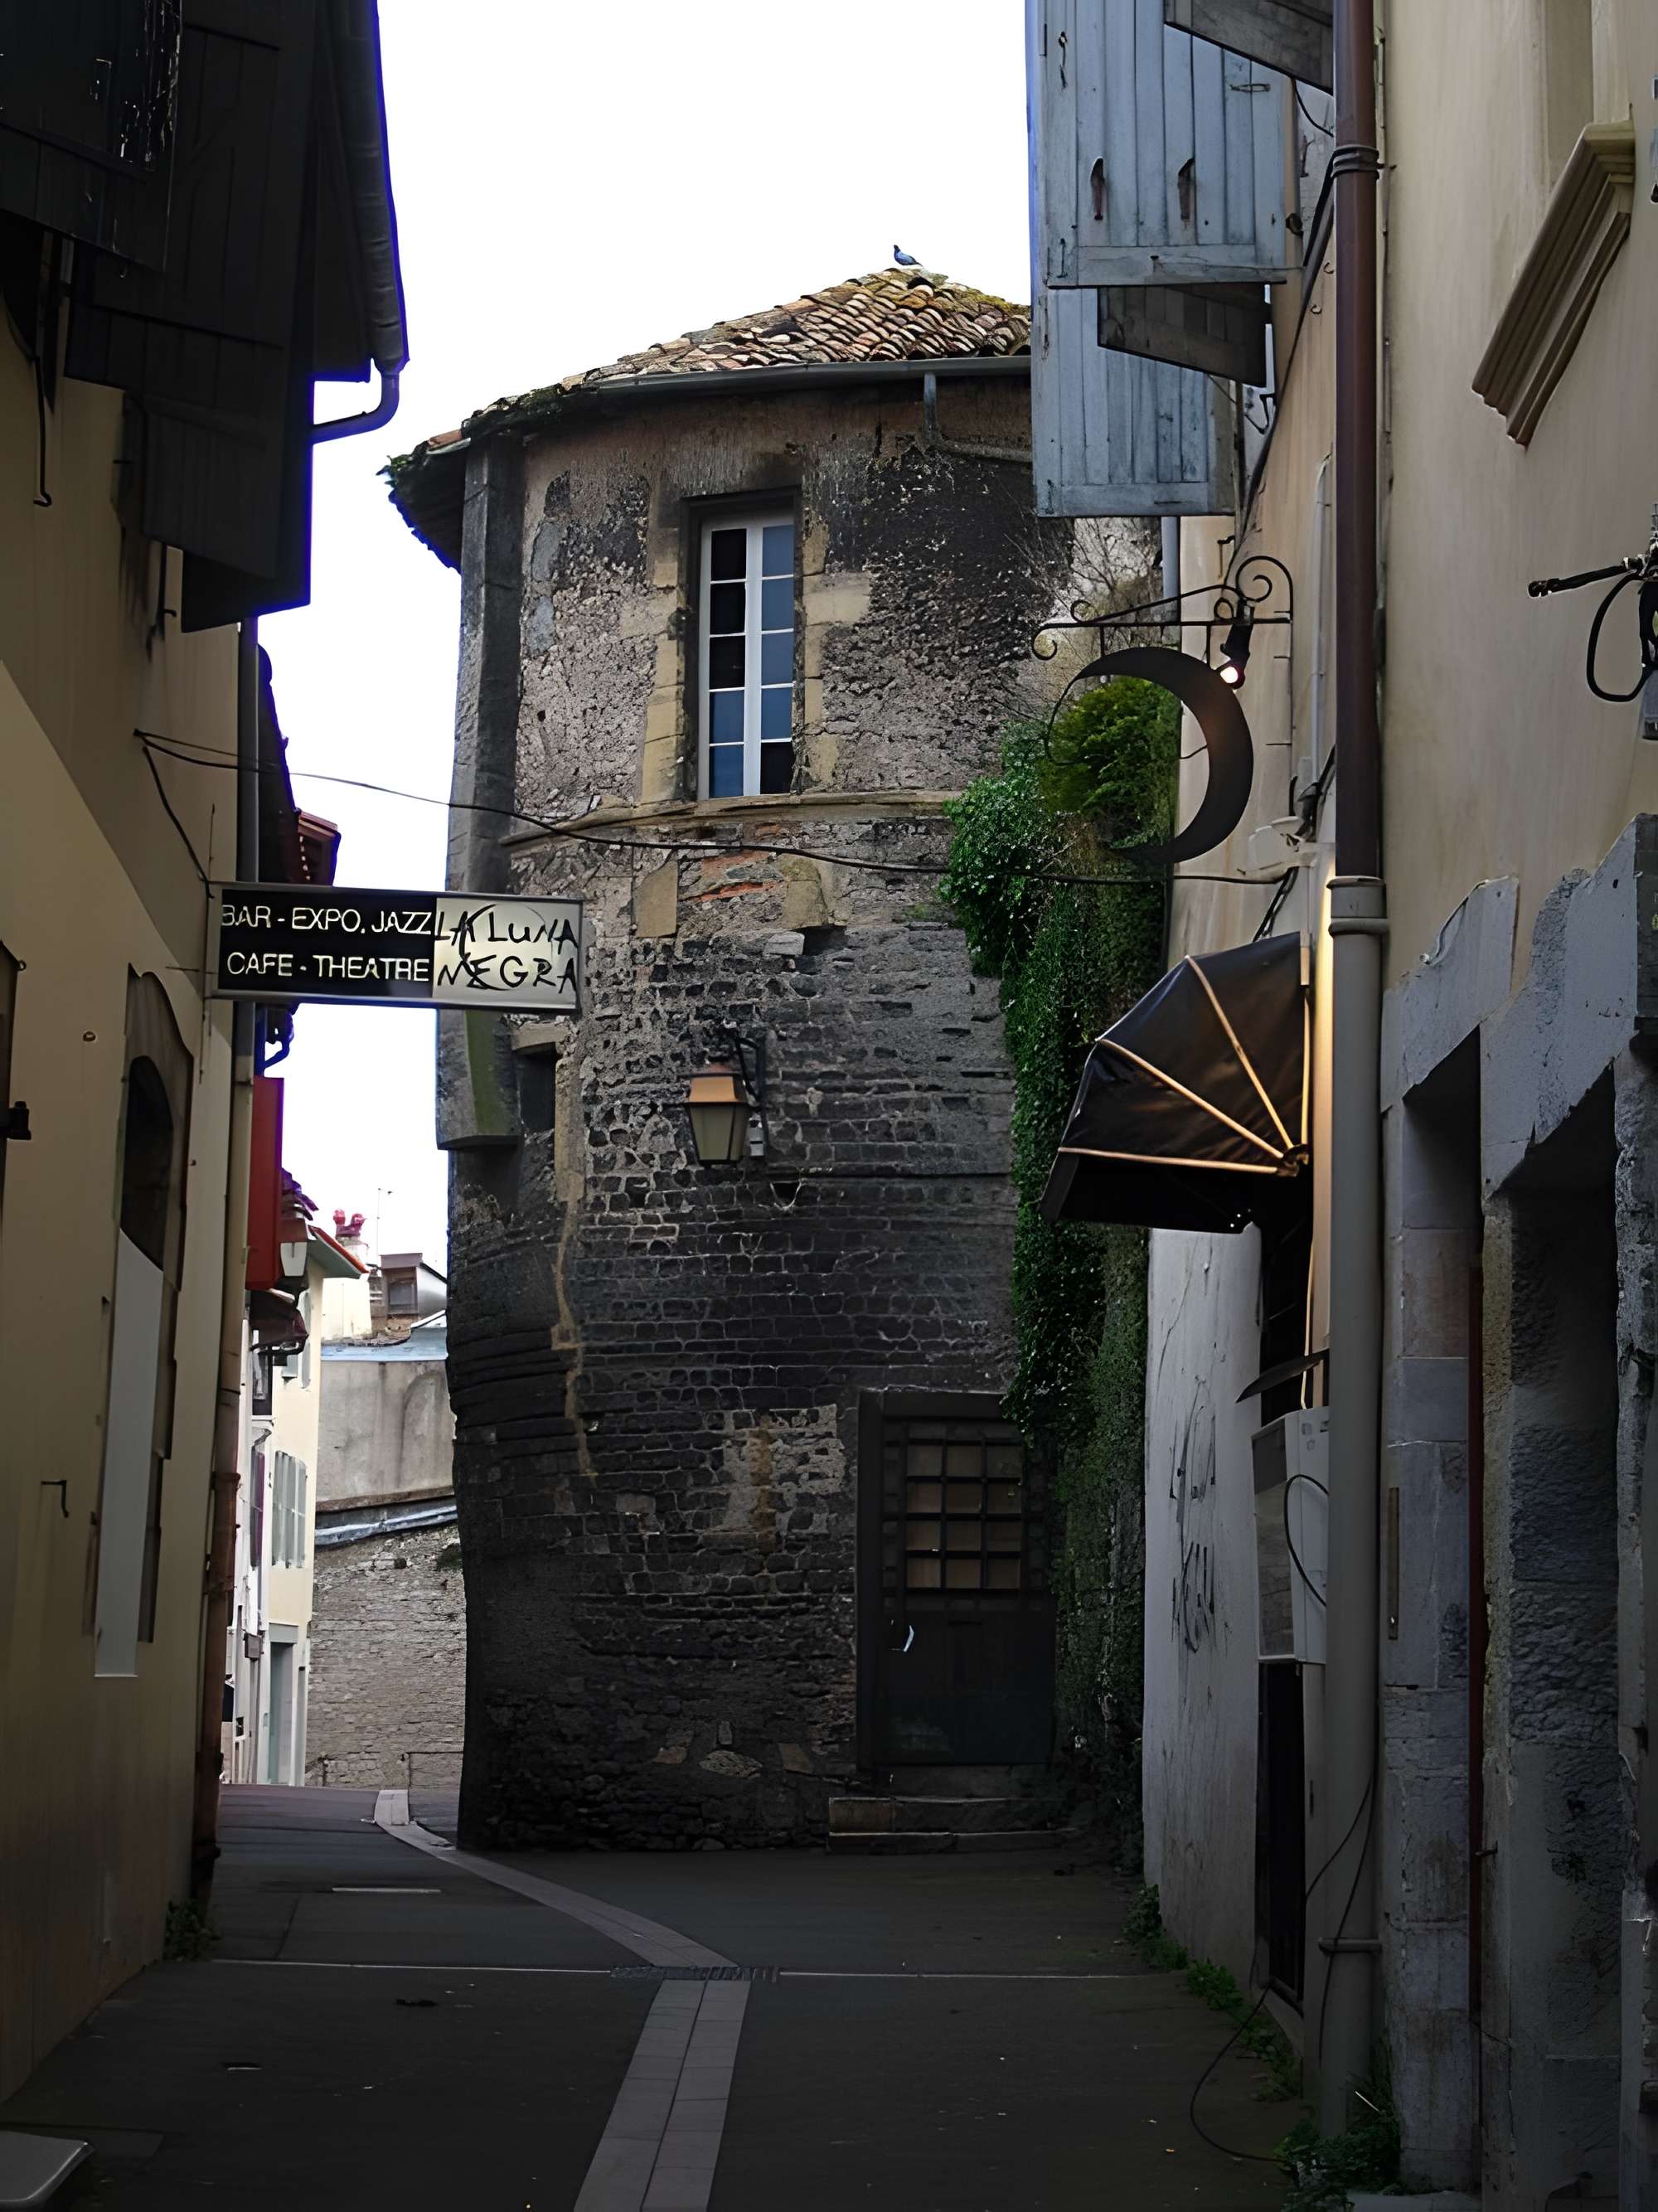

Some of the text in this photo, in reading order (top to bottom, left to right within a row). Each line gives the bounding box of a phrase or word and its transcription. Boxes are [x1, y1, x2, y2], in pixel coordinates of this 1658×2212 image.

[221, 905, 271, 928] BAR
[371, 910, 432, 935] JAZZ
[434, 910, 476, 946] LA
[227, 952, 293, 977] CAFE
[312, 954, 429, 982] THEATRE
[437, 952, 578, 994] NEGRA
